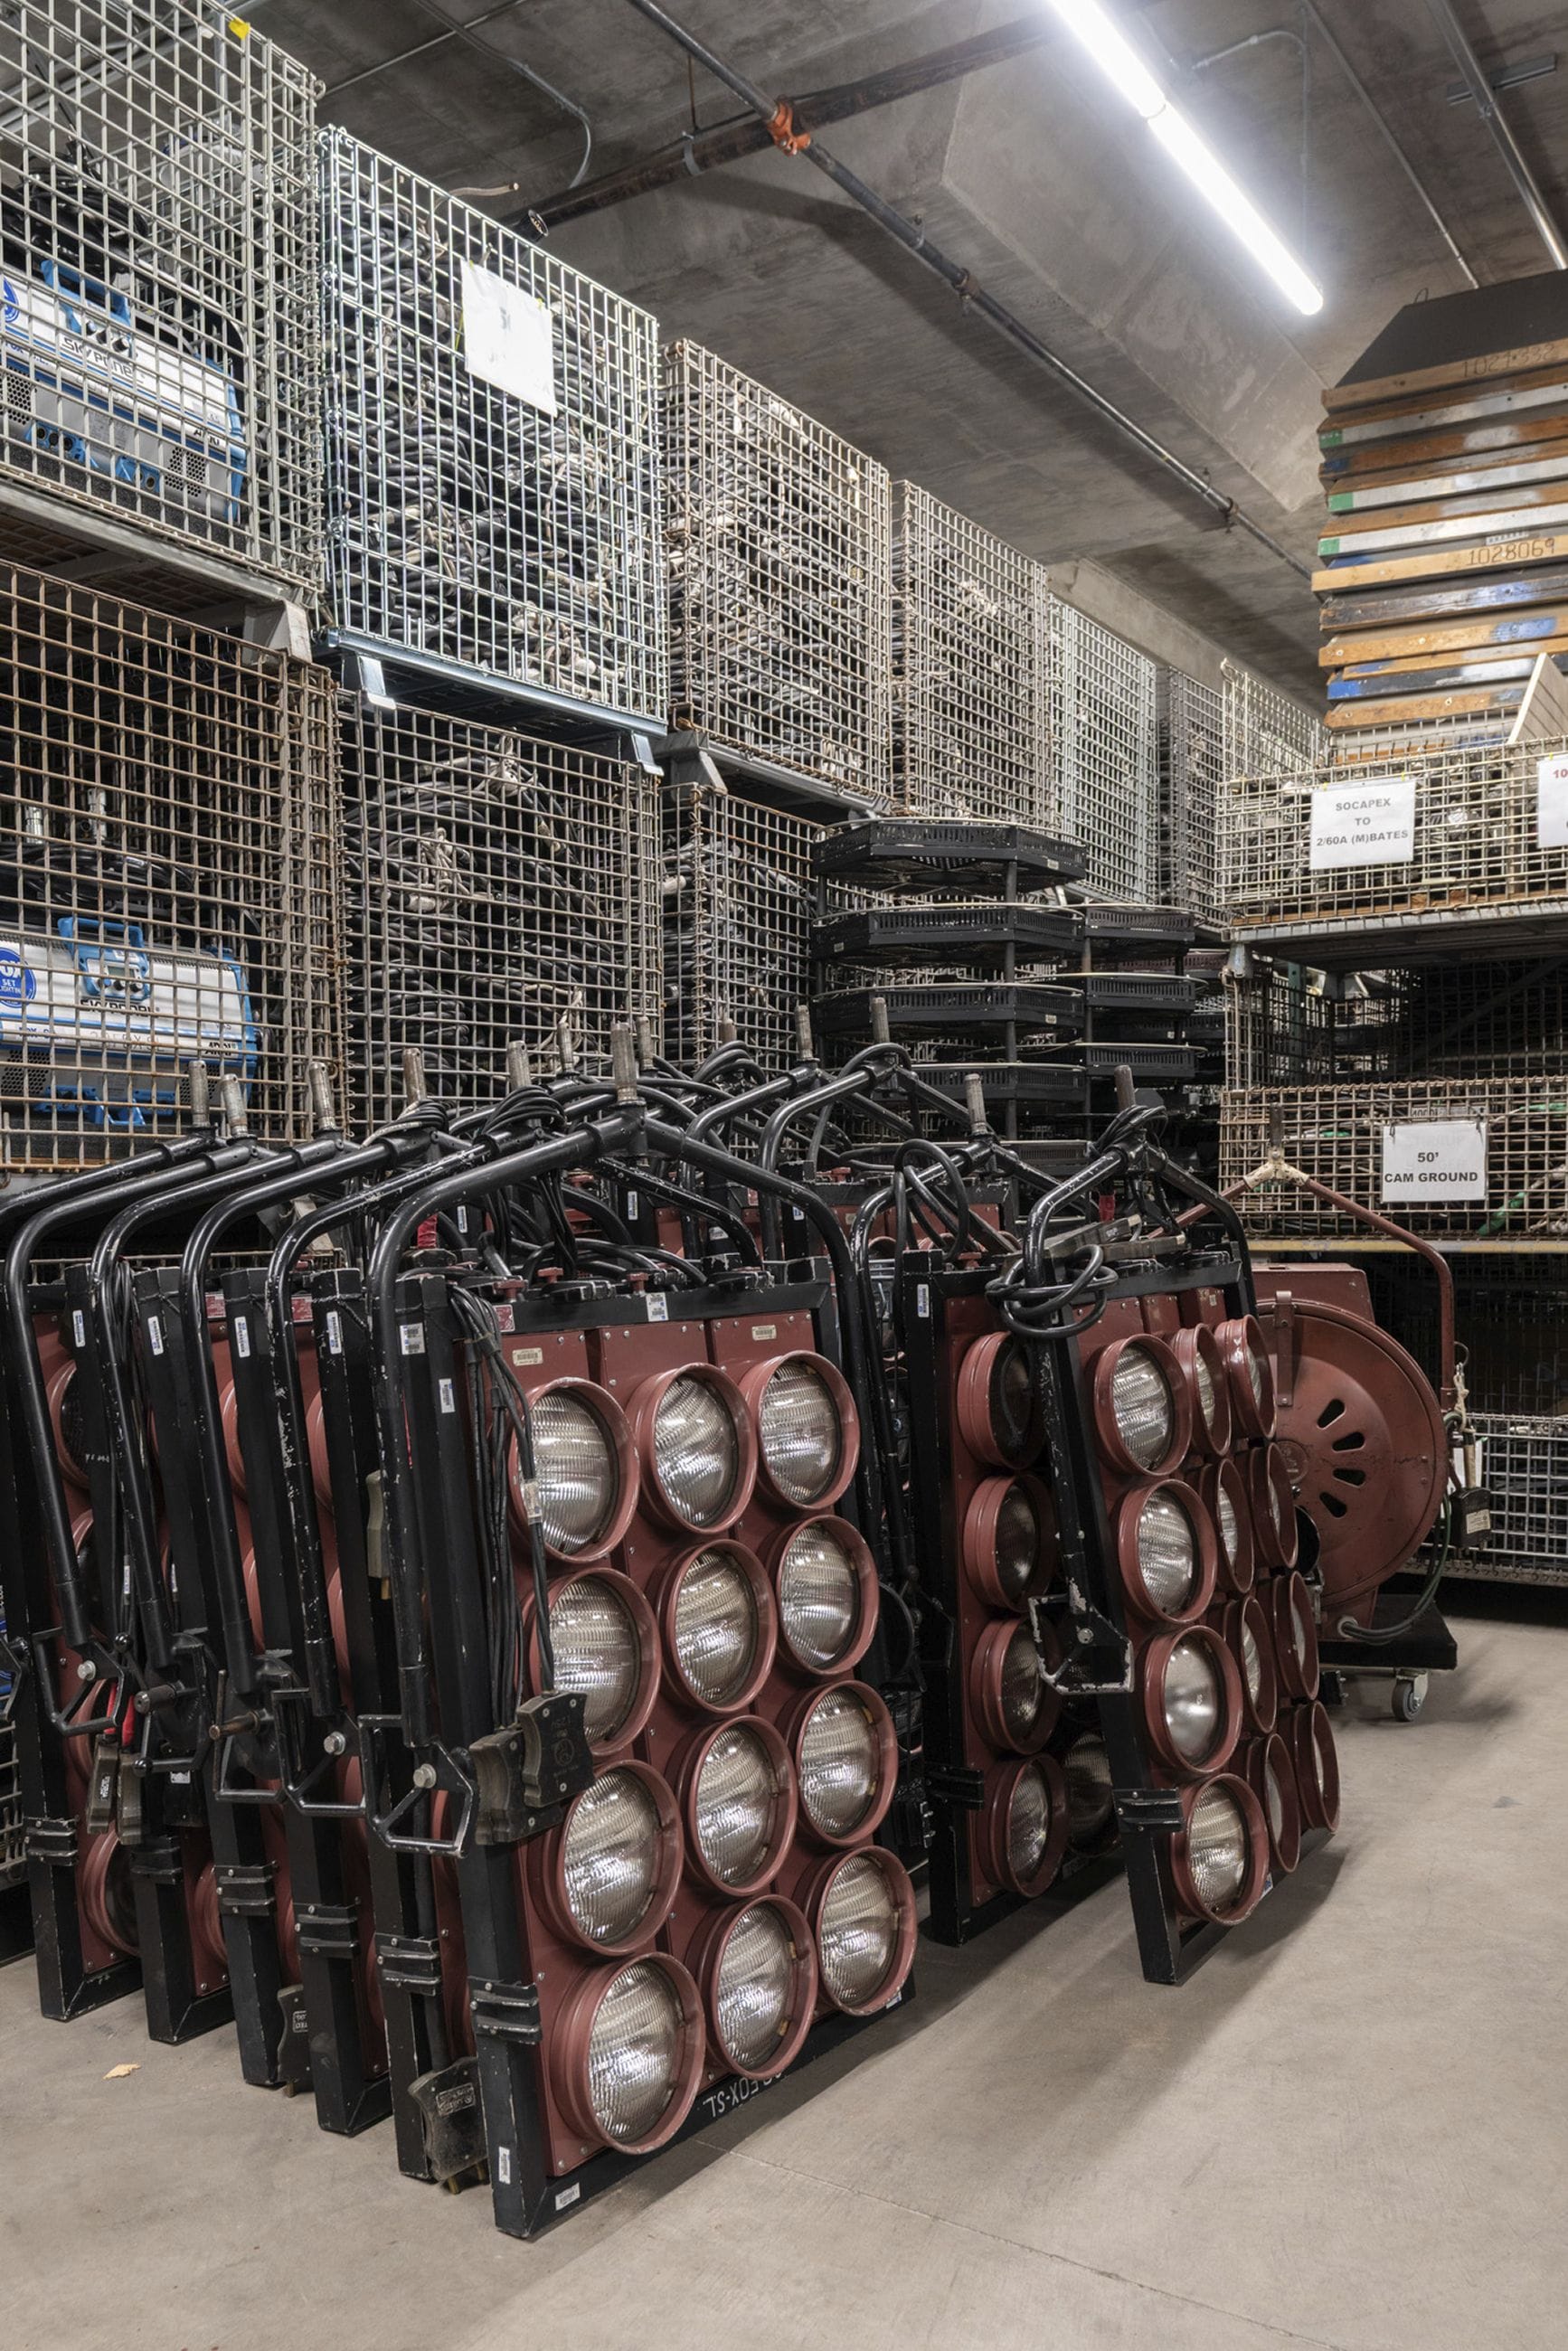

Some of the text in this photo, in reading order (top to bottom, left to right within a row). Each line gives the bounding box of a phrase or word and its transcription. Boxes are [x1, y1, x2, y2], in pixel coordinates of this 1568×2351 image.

[1466, 537, 1554, 566] 1028069
[1336, 798, 1392, 812] SOCAPEX
[1355, 817, 1371, 826] TO
[1317, 830, 1409, 846] 2/60A (M)BATES
[2, 978, 15, 987] SET
[1417, 1152, 1440, 1163] 50'
[1384, 1172, 1478, 1183] CAM GROUND
